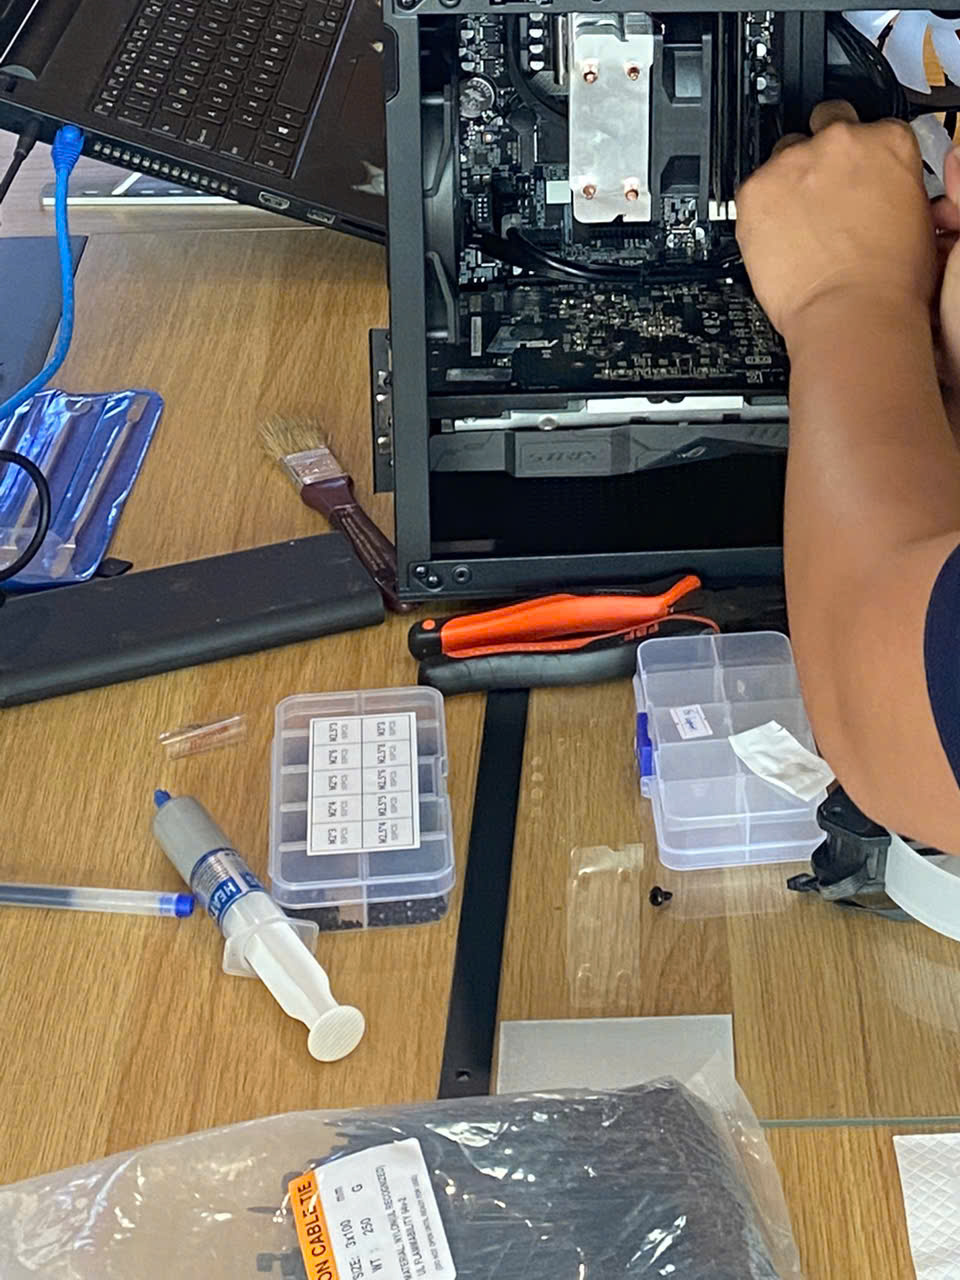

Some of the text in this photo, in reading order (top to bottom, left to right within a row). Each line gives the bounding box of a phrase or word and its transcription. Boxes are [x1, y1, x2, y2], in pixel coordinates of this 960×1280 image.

[297, 1180, 313, 1206] TIE
[302, 1205, 326, 1257] CABLE
[340, 1219, 356, 1248] 3x100
[352, 1184, 383, 1273] WT 250 G
[403, 1215, 423, 1265] FLAMMABILITY
[349, 1256, 364, 1280] SIZE:
